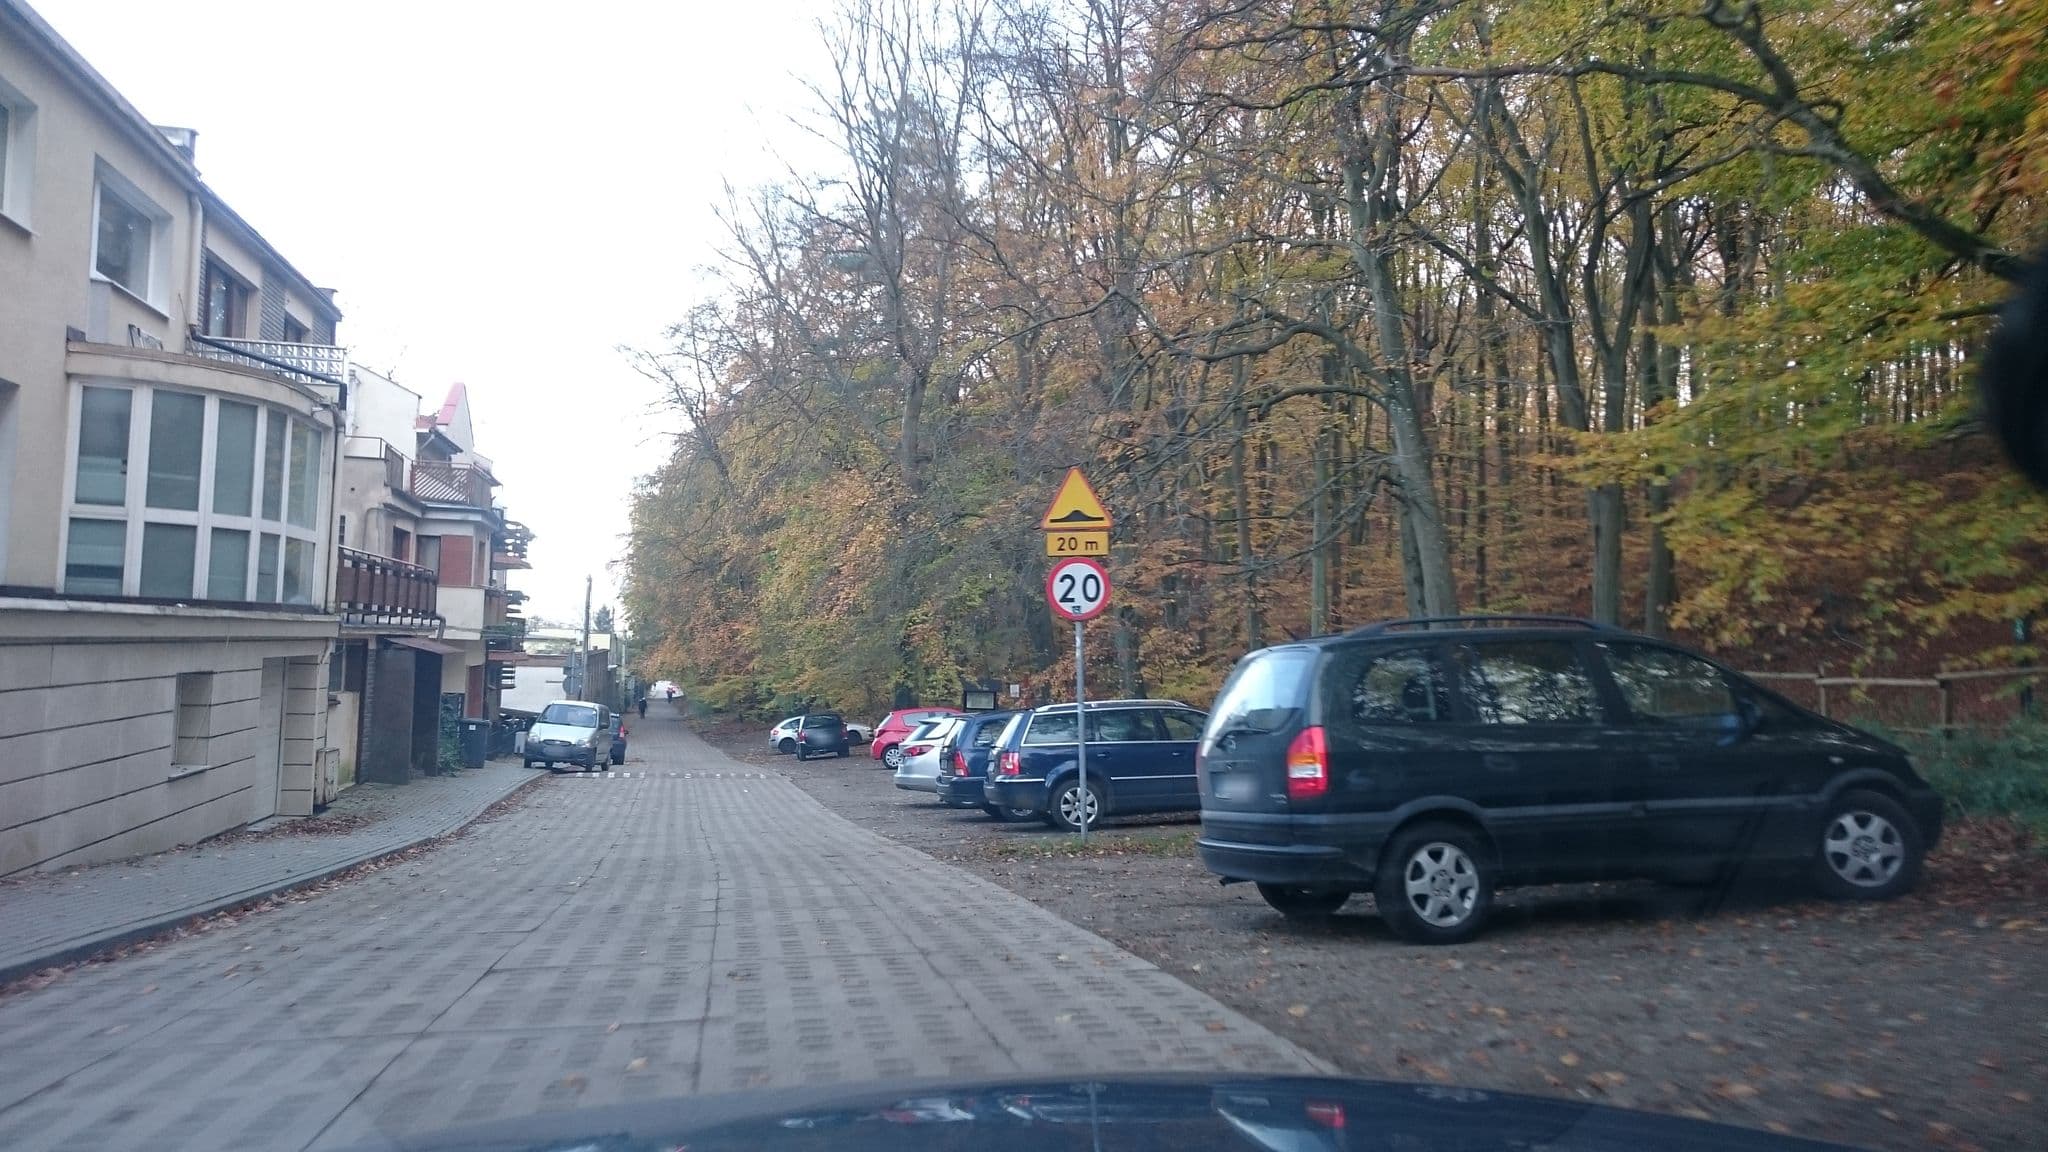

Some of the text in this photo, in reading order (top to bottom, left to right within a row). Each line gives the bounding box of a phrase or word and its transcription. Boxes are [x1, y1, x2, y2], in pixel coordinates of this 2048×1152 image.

[1057, 537, 1098, 551] 20 m
[1059, 573, 1101, 603] 20
